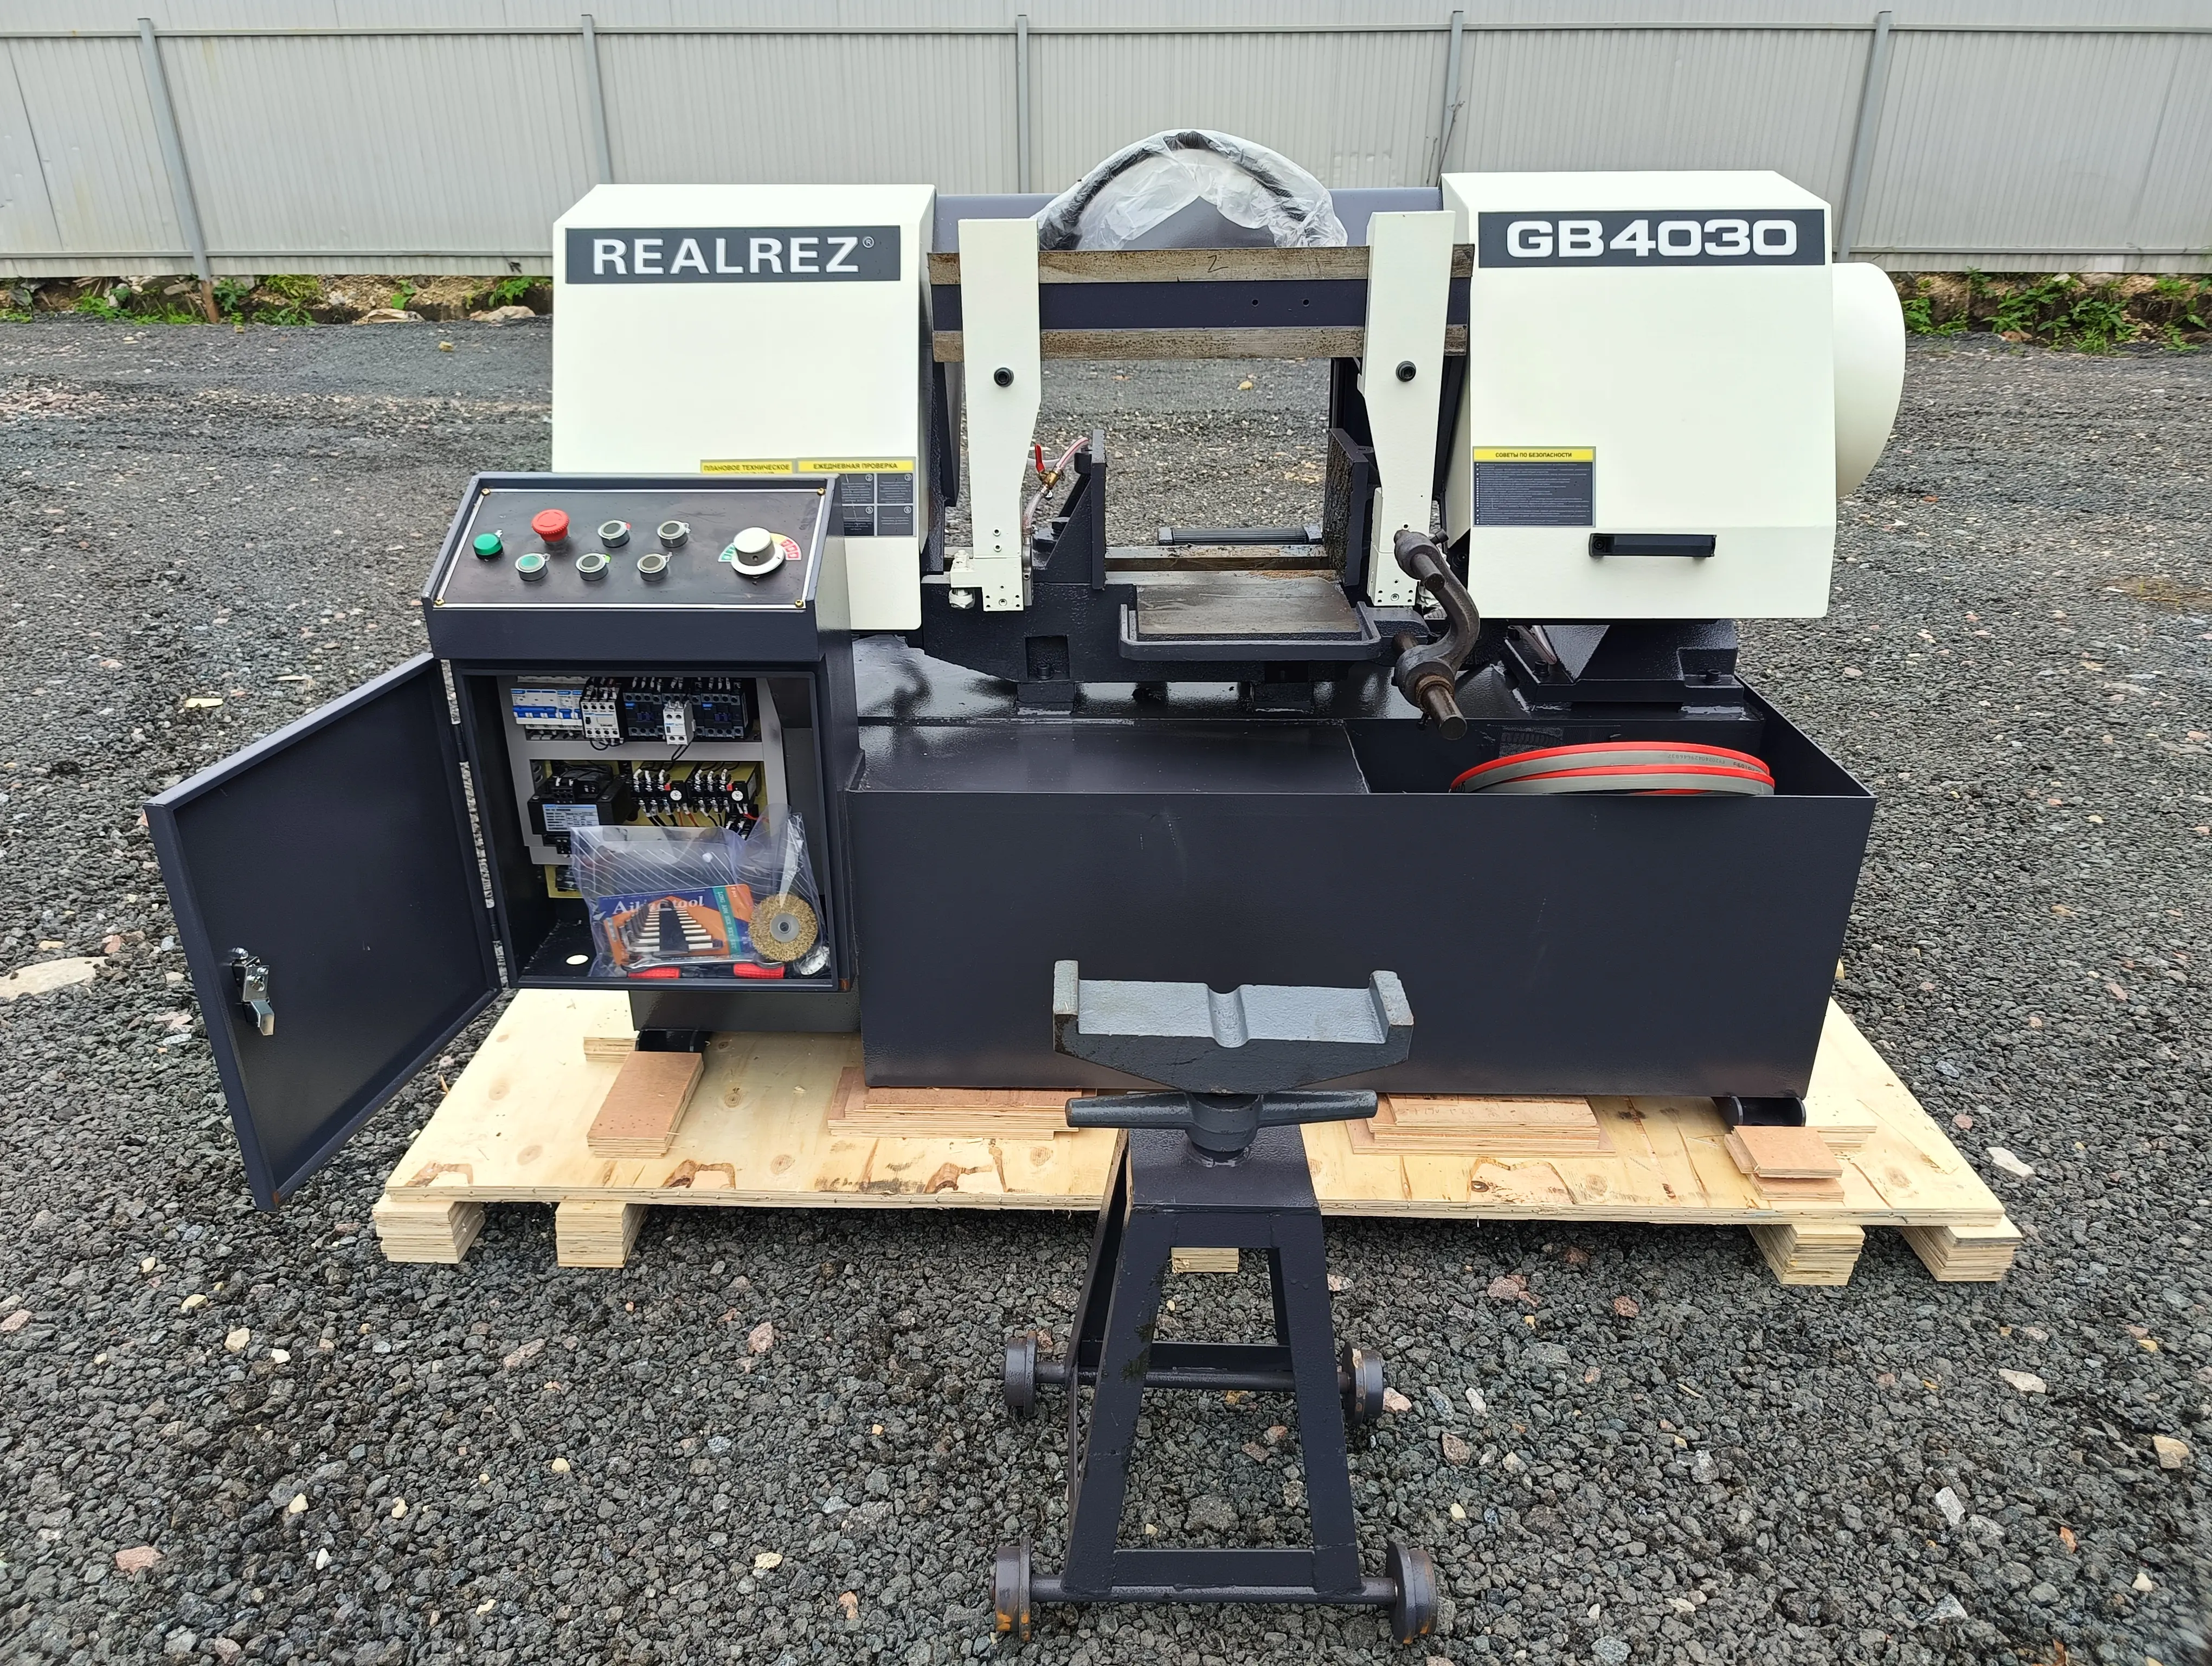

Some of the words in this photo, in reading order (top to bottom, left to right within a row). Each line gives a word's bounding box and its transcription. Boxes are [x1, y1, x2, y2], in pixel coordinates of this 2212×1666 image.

[1507, 219, 1798, 258] GB4030
[673, 896, 705, 908] tool
[716, 891, 725, 903] LONG
